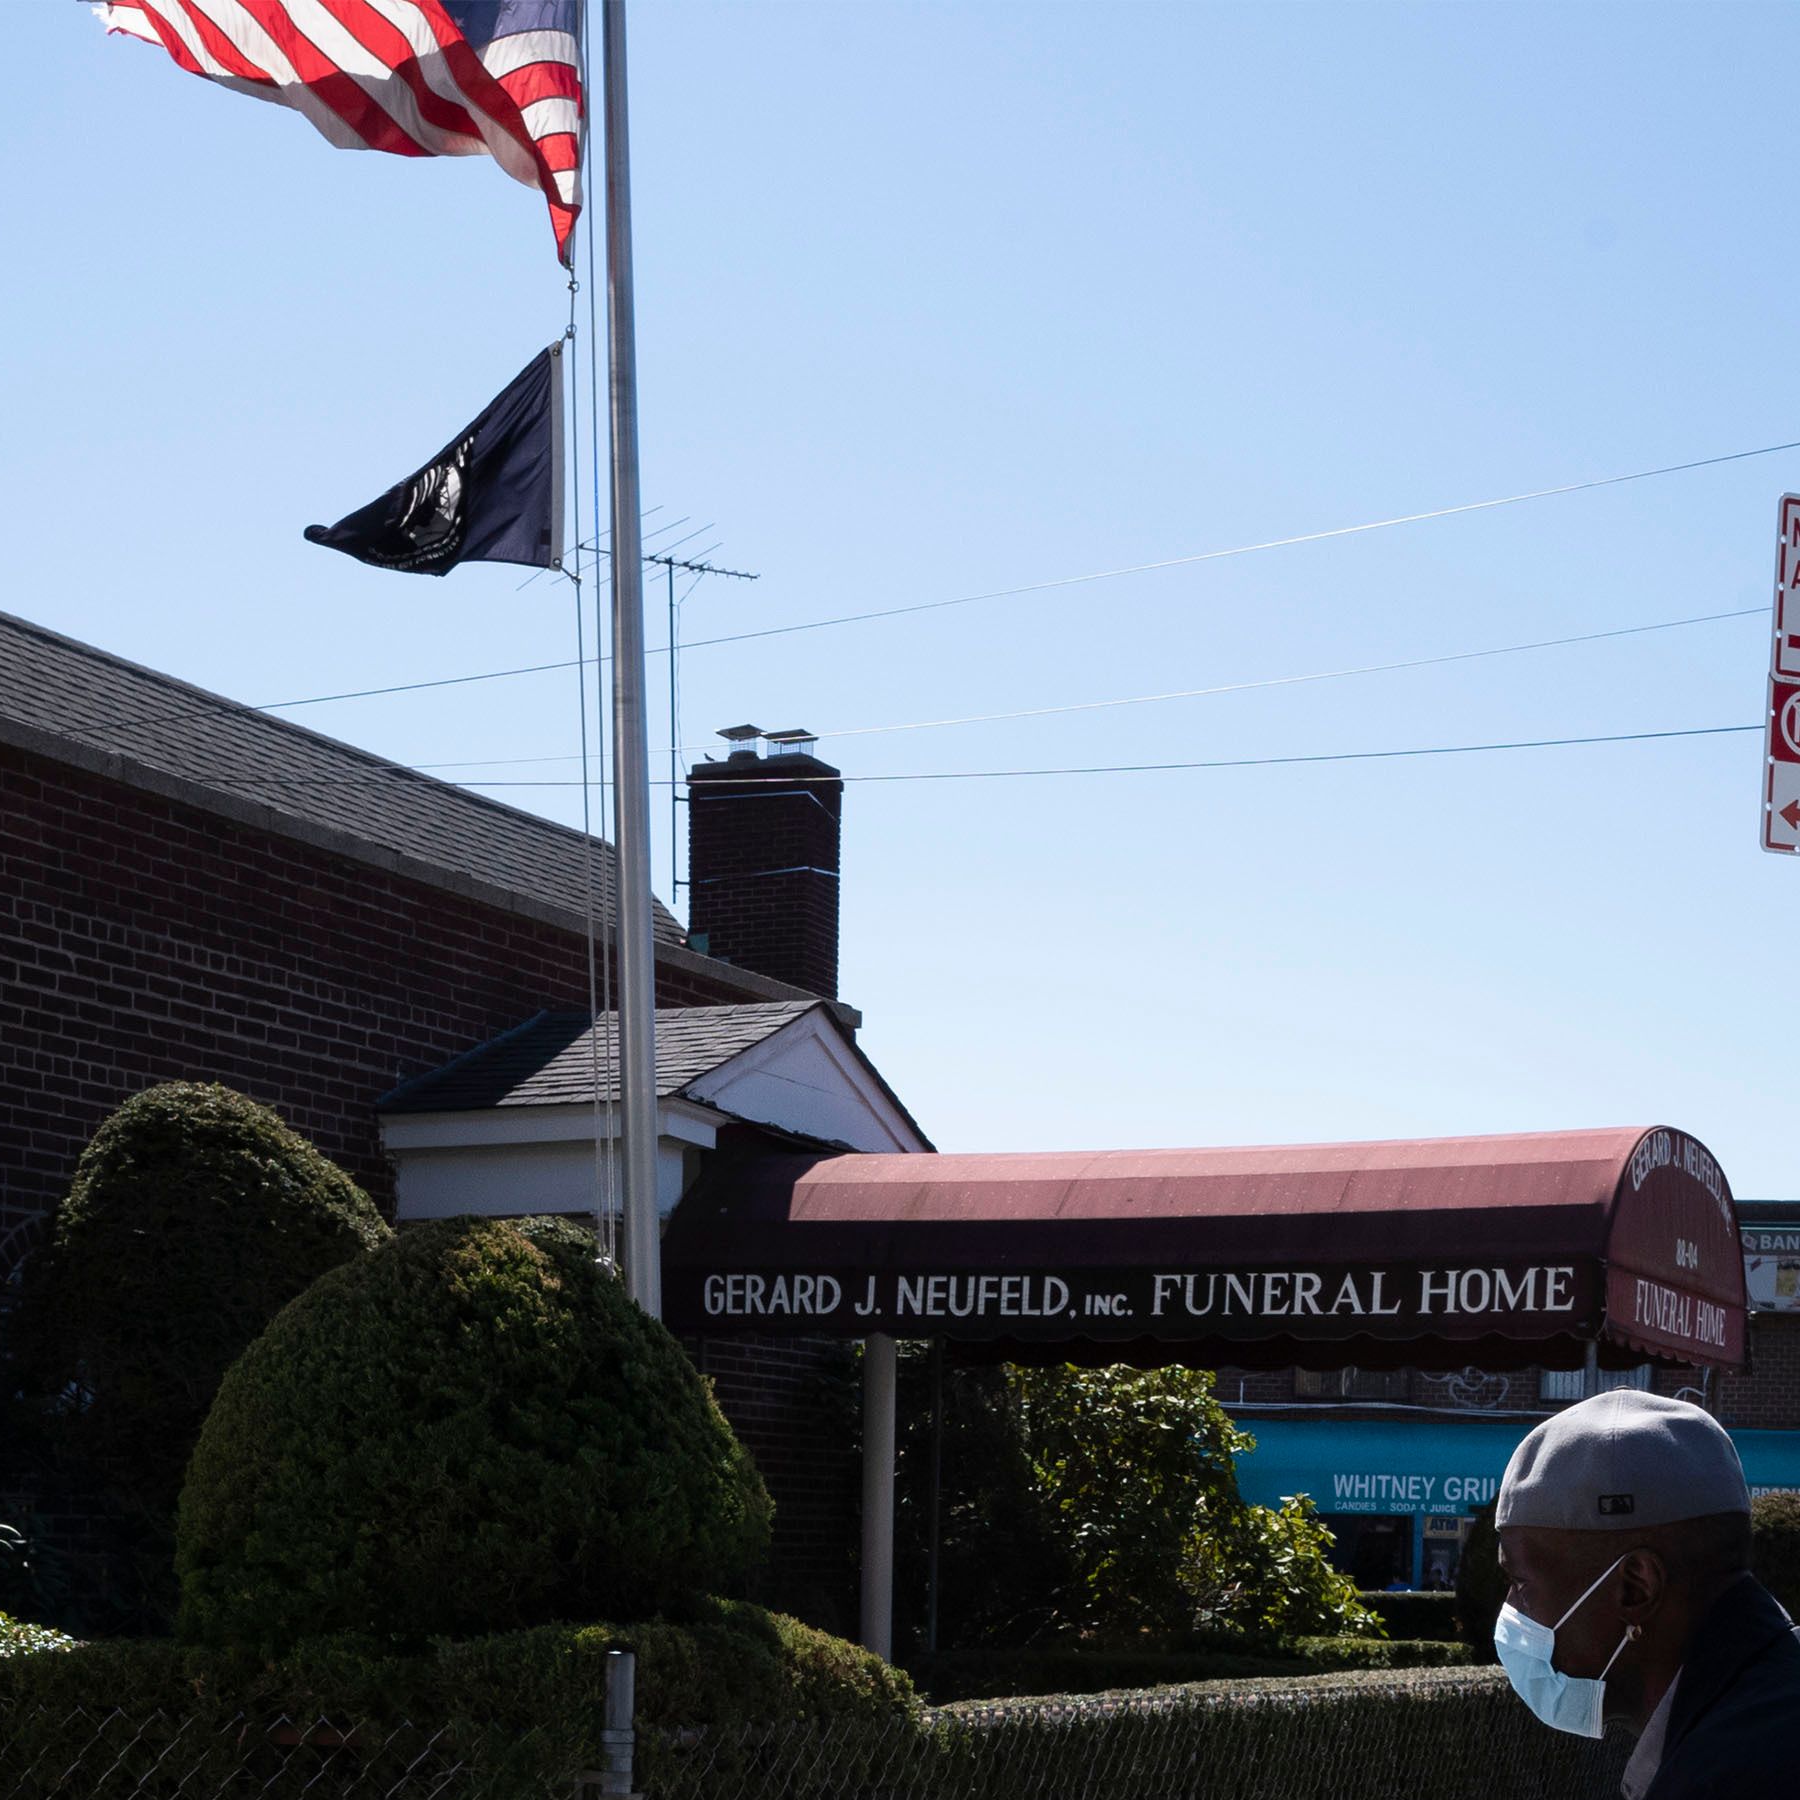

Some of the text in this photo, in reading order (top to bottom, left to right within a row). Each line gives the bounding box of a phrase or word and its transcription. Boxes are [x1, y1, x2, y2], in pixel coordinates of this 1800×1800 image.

[1631, 1131, 1672, 1191] GERARD
[1673, 1134, 1682, 1169] J.
[703, 1266, 1576, 1319] GERARD J. NEUFELD, INC. FUNERAL HOME
[1634, 1278, 1727, 1347] FUNERAL HOME
[1333, 1474, 1436, 1501] WHITNEY
[1334, 1501, 1377, 1512] CANDIES
[1389, 1502, 1416, 1513] SODA
[1429, 1503, 1457, 1514] JUICE
[1430, 1518, 1459, 1532] ATM
